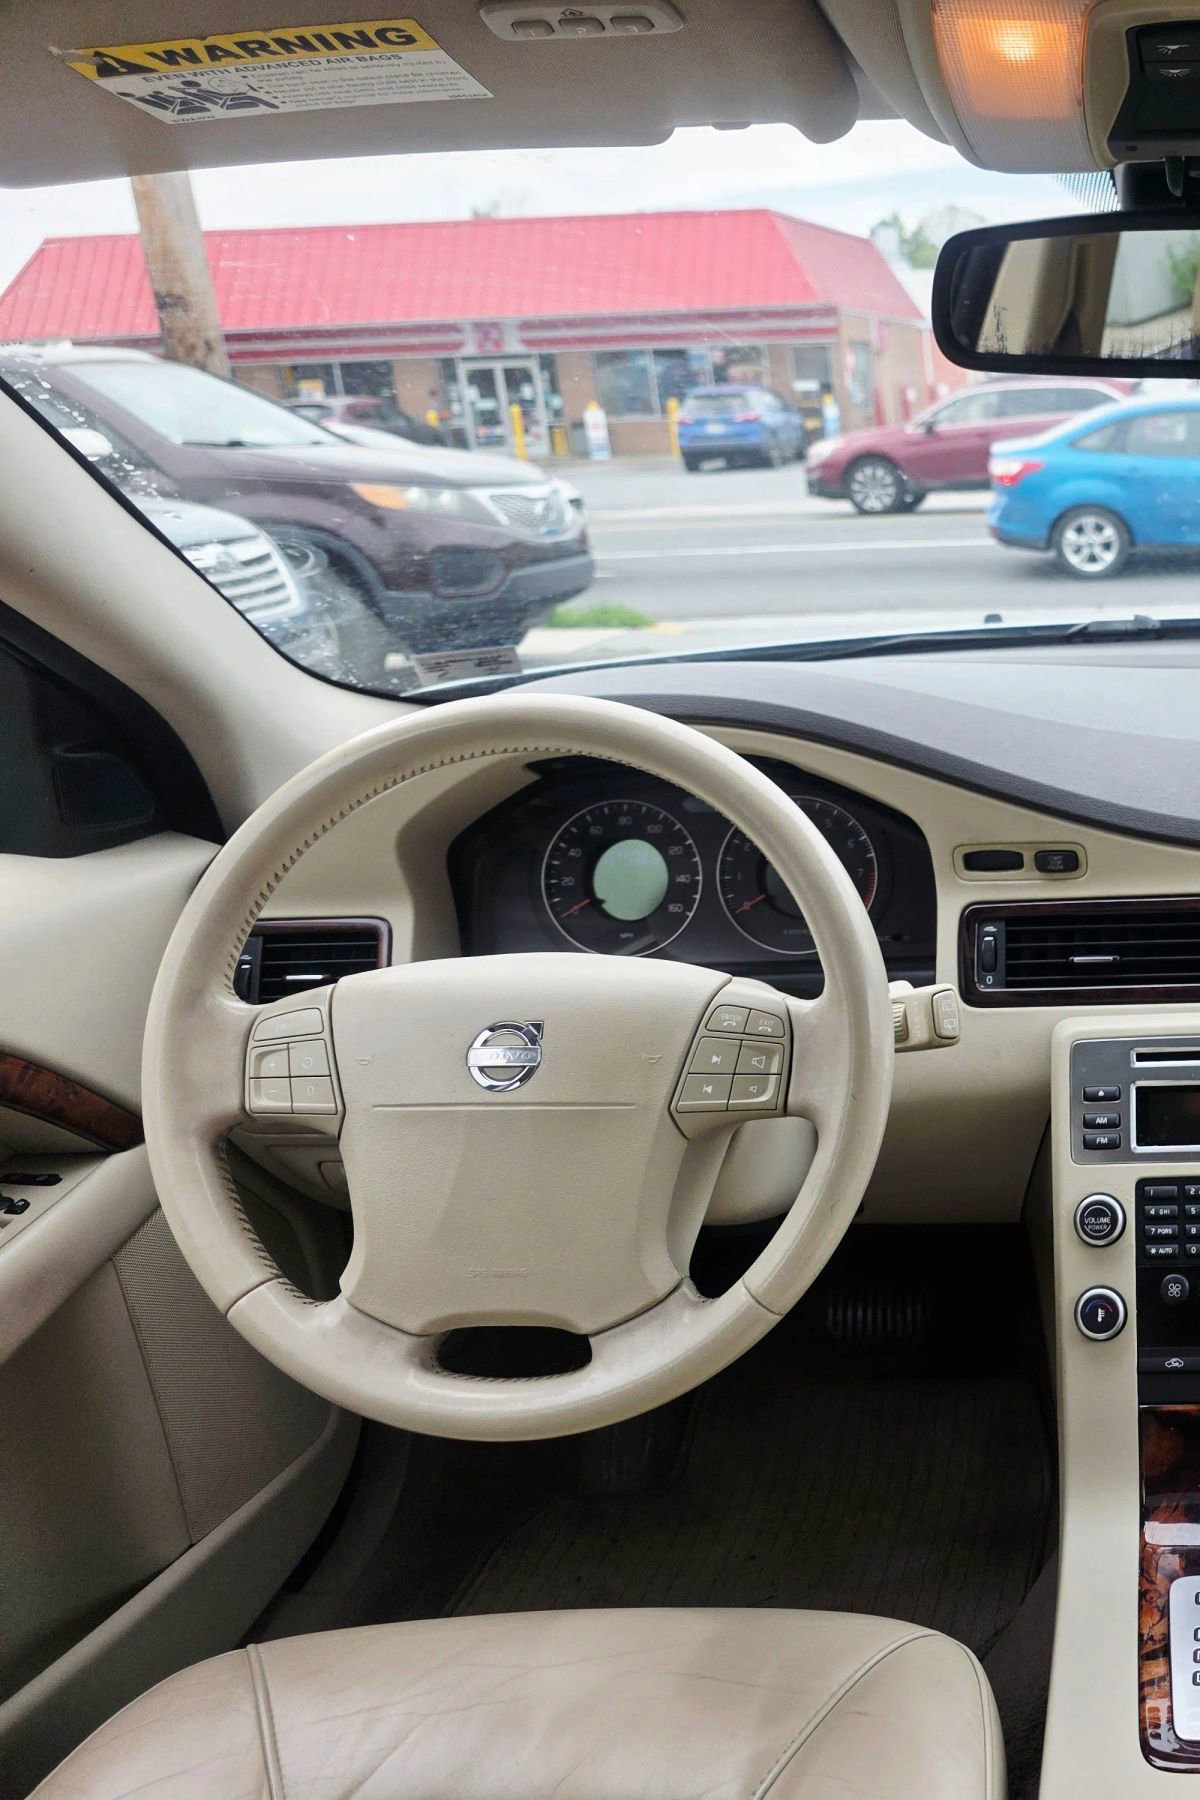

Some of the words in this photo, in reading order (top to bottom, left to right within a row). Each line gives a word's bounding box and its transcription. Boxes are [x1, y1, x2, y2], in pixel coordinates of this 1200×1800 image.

[145, 27, 417, 67] WARNING
[142, 70, 188, 84] EVEN
[188, 66, 234, 78] WITH
[234, 59, 324, 73] ADVANCED
[323, 56, 354, 66] AIR
[356, 53, 403, 64] BAGS
[1095, 1117, 1108, 1125] AM
[1096, 1137, 1108, 1145] FM
[1190, 1207, 1196, 1215] 5
[1084, 1216, 1111, 1224] VOLUME
[1150, 1227, 1156, 1235] 7
[1191, 1226, 1197, 1235] 8
